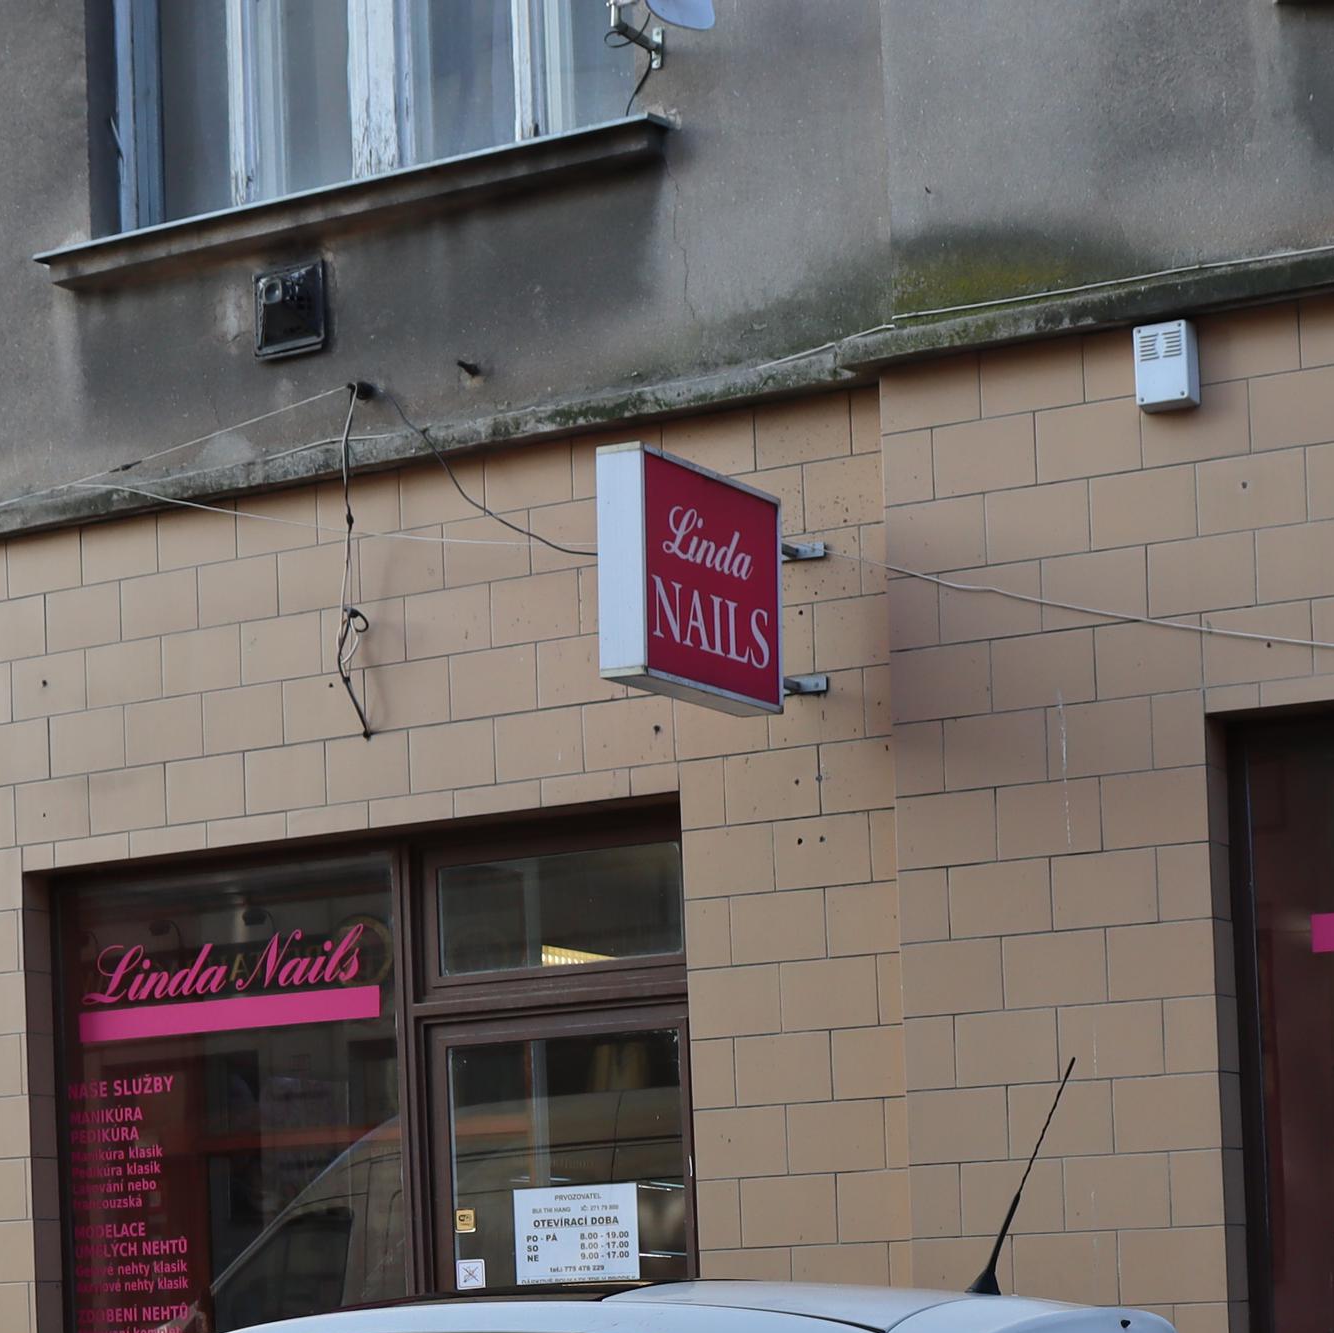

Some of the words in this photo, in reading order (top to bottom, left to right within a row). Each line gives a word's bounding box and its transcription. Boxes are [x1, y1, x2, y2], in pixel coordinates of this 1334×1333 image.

[662, 506, 754, 582] Linda
[651, 574, 771, 670] NAILS
[82, 943, 229, 1006] Linda
[234, 922, 364, 991] Nails
[68, 1079, 108, 1099] NAŠE
[113, 1073, 174, 1096] SLUŽBY
[69, 1104, 143, 1125] MANIKÚRA
[70, 1124, 140, 1144] PEDIKÚRA
[128, 1144, 163, 1159] klasik
[126, 1161, 161, 1175] klasik
[127, 1178, 157, 1191] nebo
[75, 1222, 146, 1239] MODELACE
[533, 1216, 588, 1228] OTEVÍRACÍ
[590, 1216, 619, 1225] DOBA
[526, 1234, 539, 1243] PO
[546, 1232, 558, 1242] PÁ
[580, 1232, 598, 1240] 8.00
[606, 1231, 629, 1239] 19.00
[606, 1241, 629, 1249] 17.00
[142, 1236, 188, 1256] NEHTŮ
[580, 1252, 599, 1260] 9.00
[607, 1251, 630, 1259] 17.00
[117, 1262, 150, 1276] nehty
[153, 1260, 188, 1274] klasik
[124, 1279, 155, 1293] nehty
[157, 1276, 189, 1289] klasik
[142, 1303, 188, 1321] NEHTŮ
